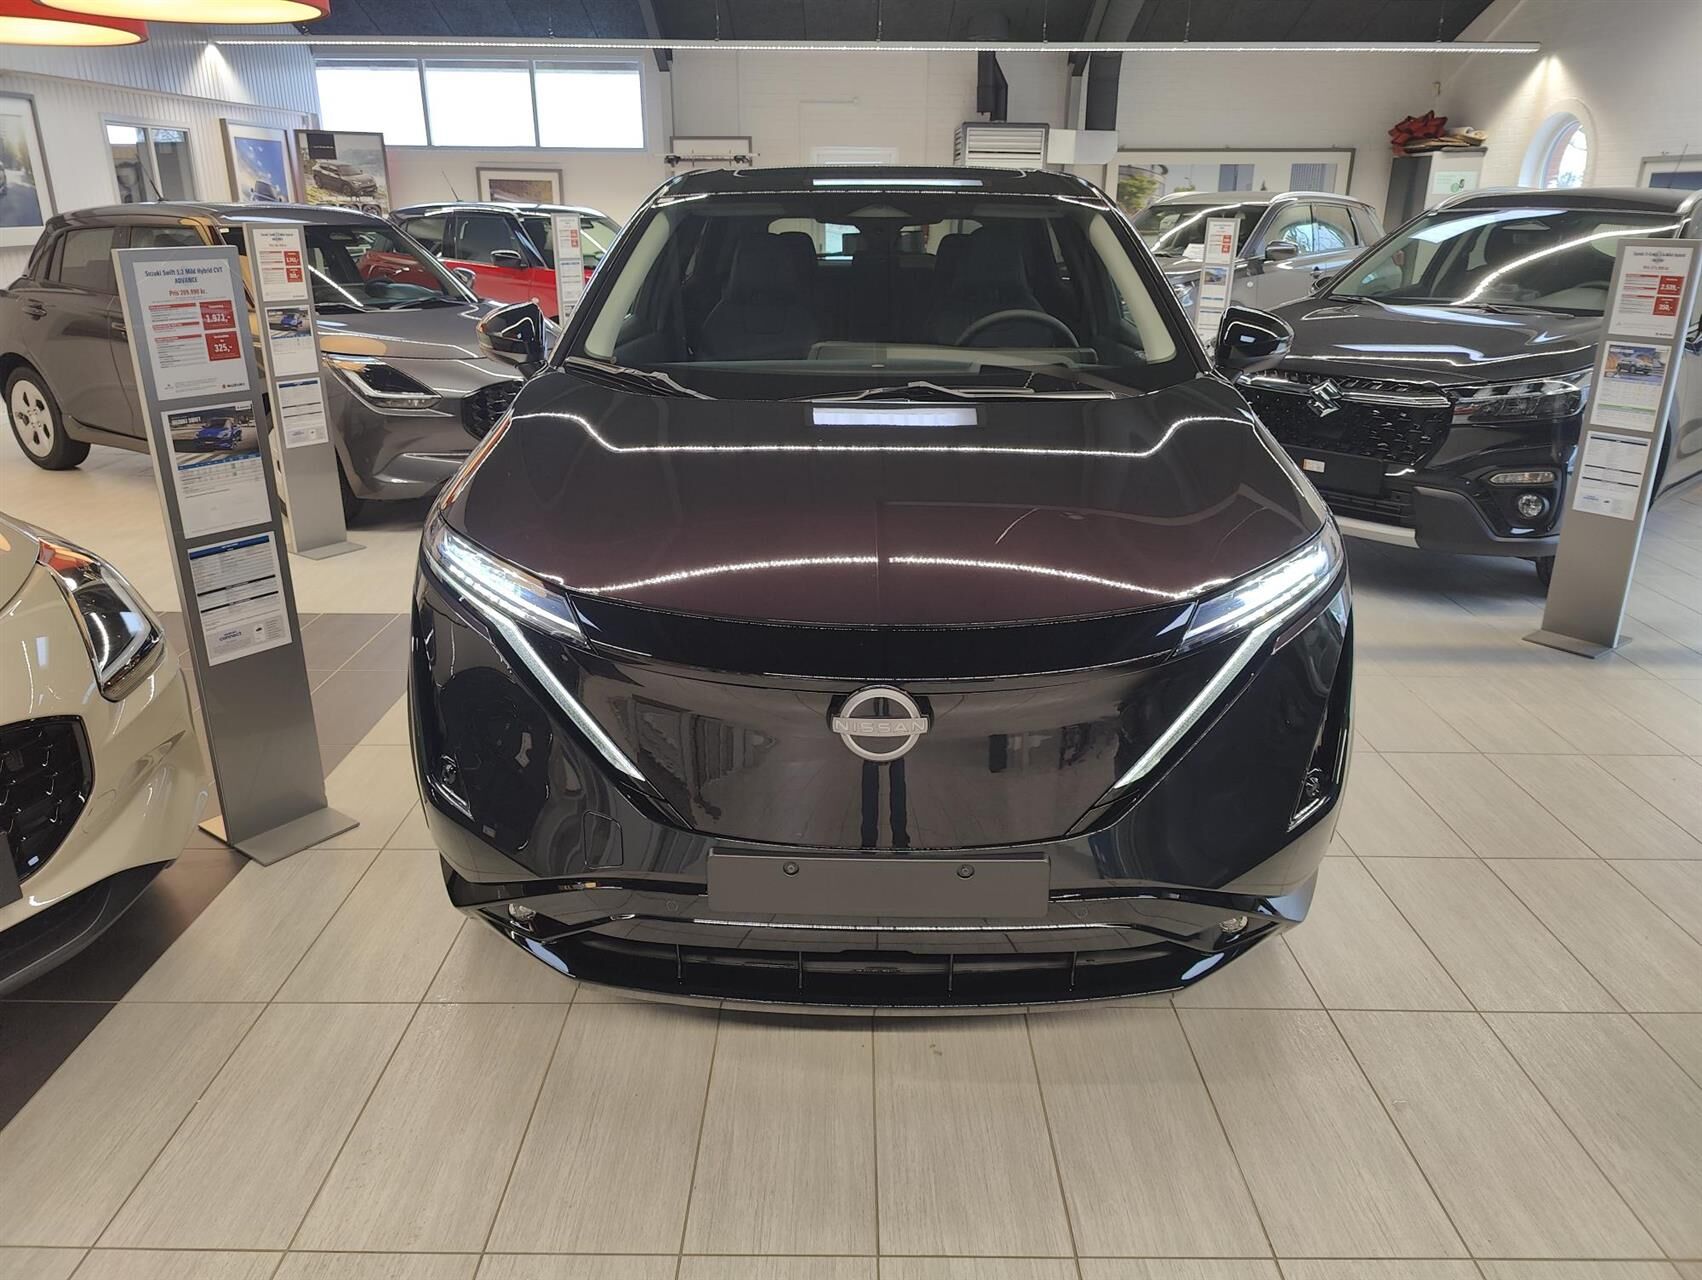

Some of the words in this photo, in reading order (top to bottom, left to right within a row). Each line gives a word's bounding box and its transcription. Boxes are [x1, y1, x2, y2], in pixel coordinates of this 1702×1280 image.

[197, 267, 213, 275] Hybrid
[214, 344, 233, 353] 325,-
[836, 720, 925, 732] NISSAN
